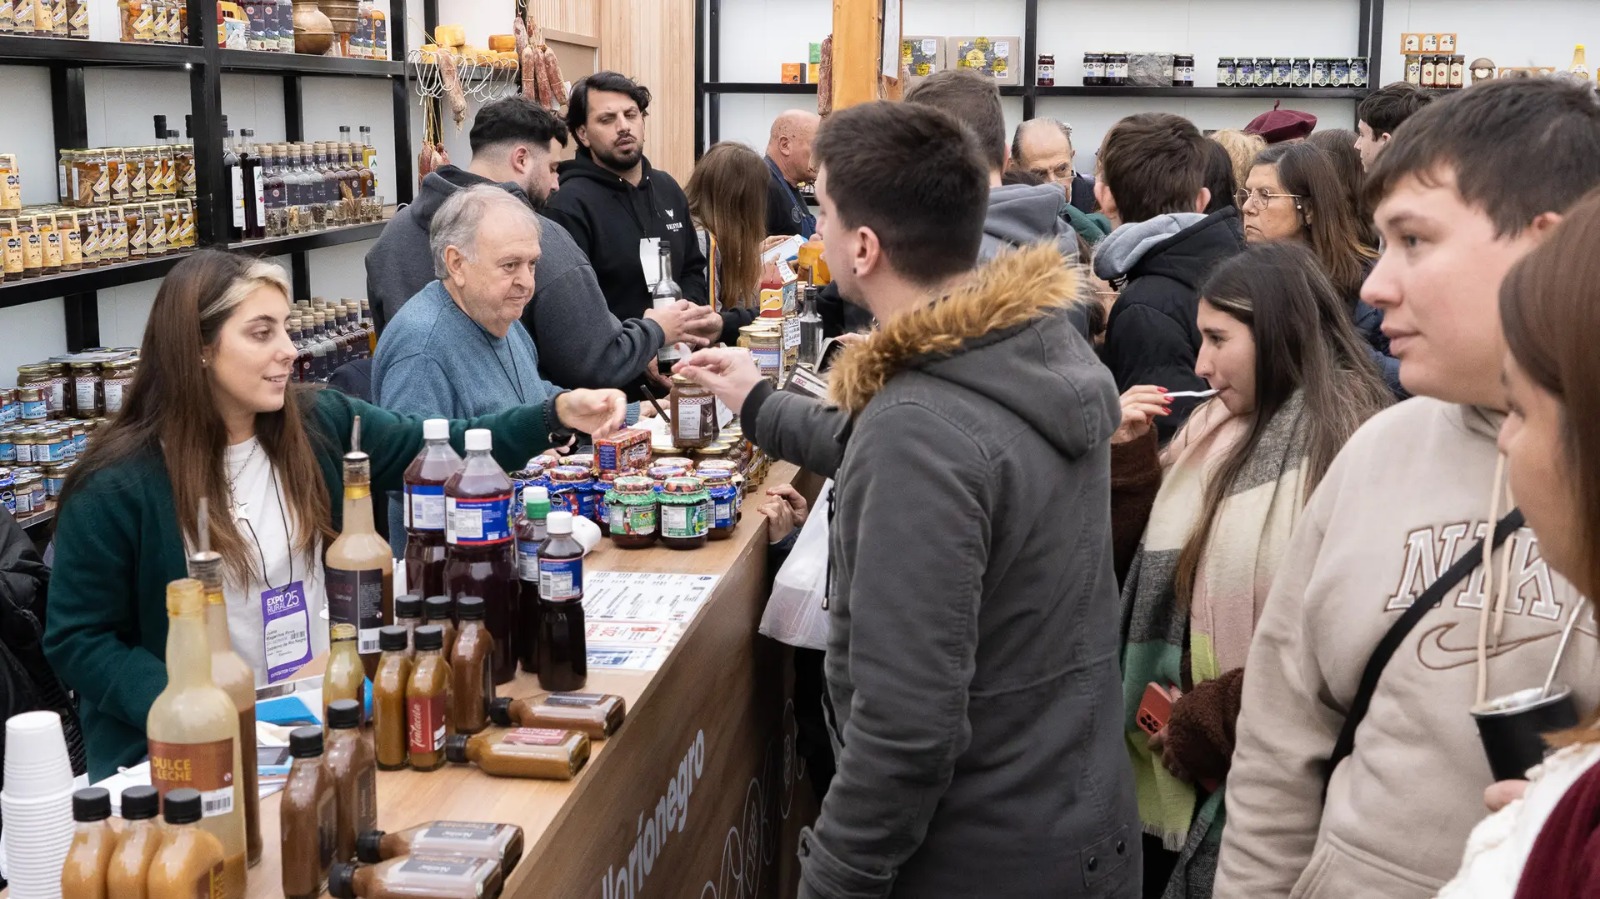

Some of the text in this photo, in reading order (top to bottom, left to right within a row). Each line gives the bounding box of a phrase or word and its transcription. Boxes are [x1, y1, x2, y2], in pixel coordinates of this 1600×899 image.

[1384, 521, 1563, 621] NIK
[267, 595, 284, 606] EXPO
[285, 591, 299, 607] 25
[267, 603, 286, 615] RURAL
[153, 757, 191, 771] DULCE
